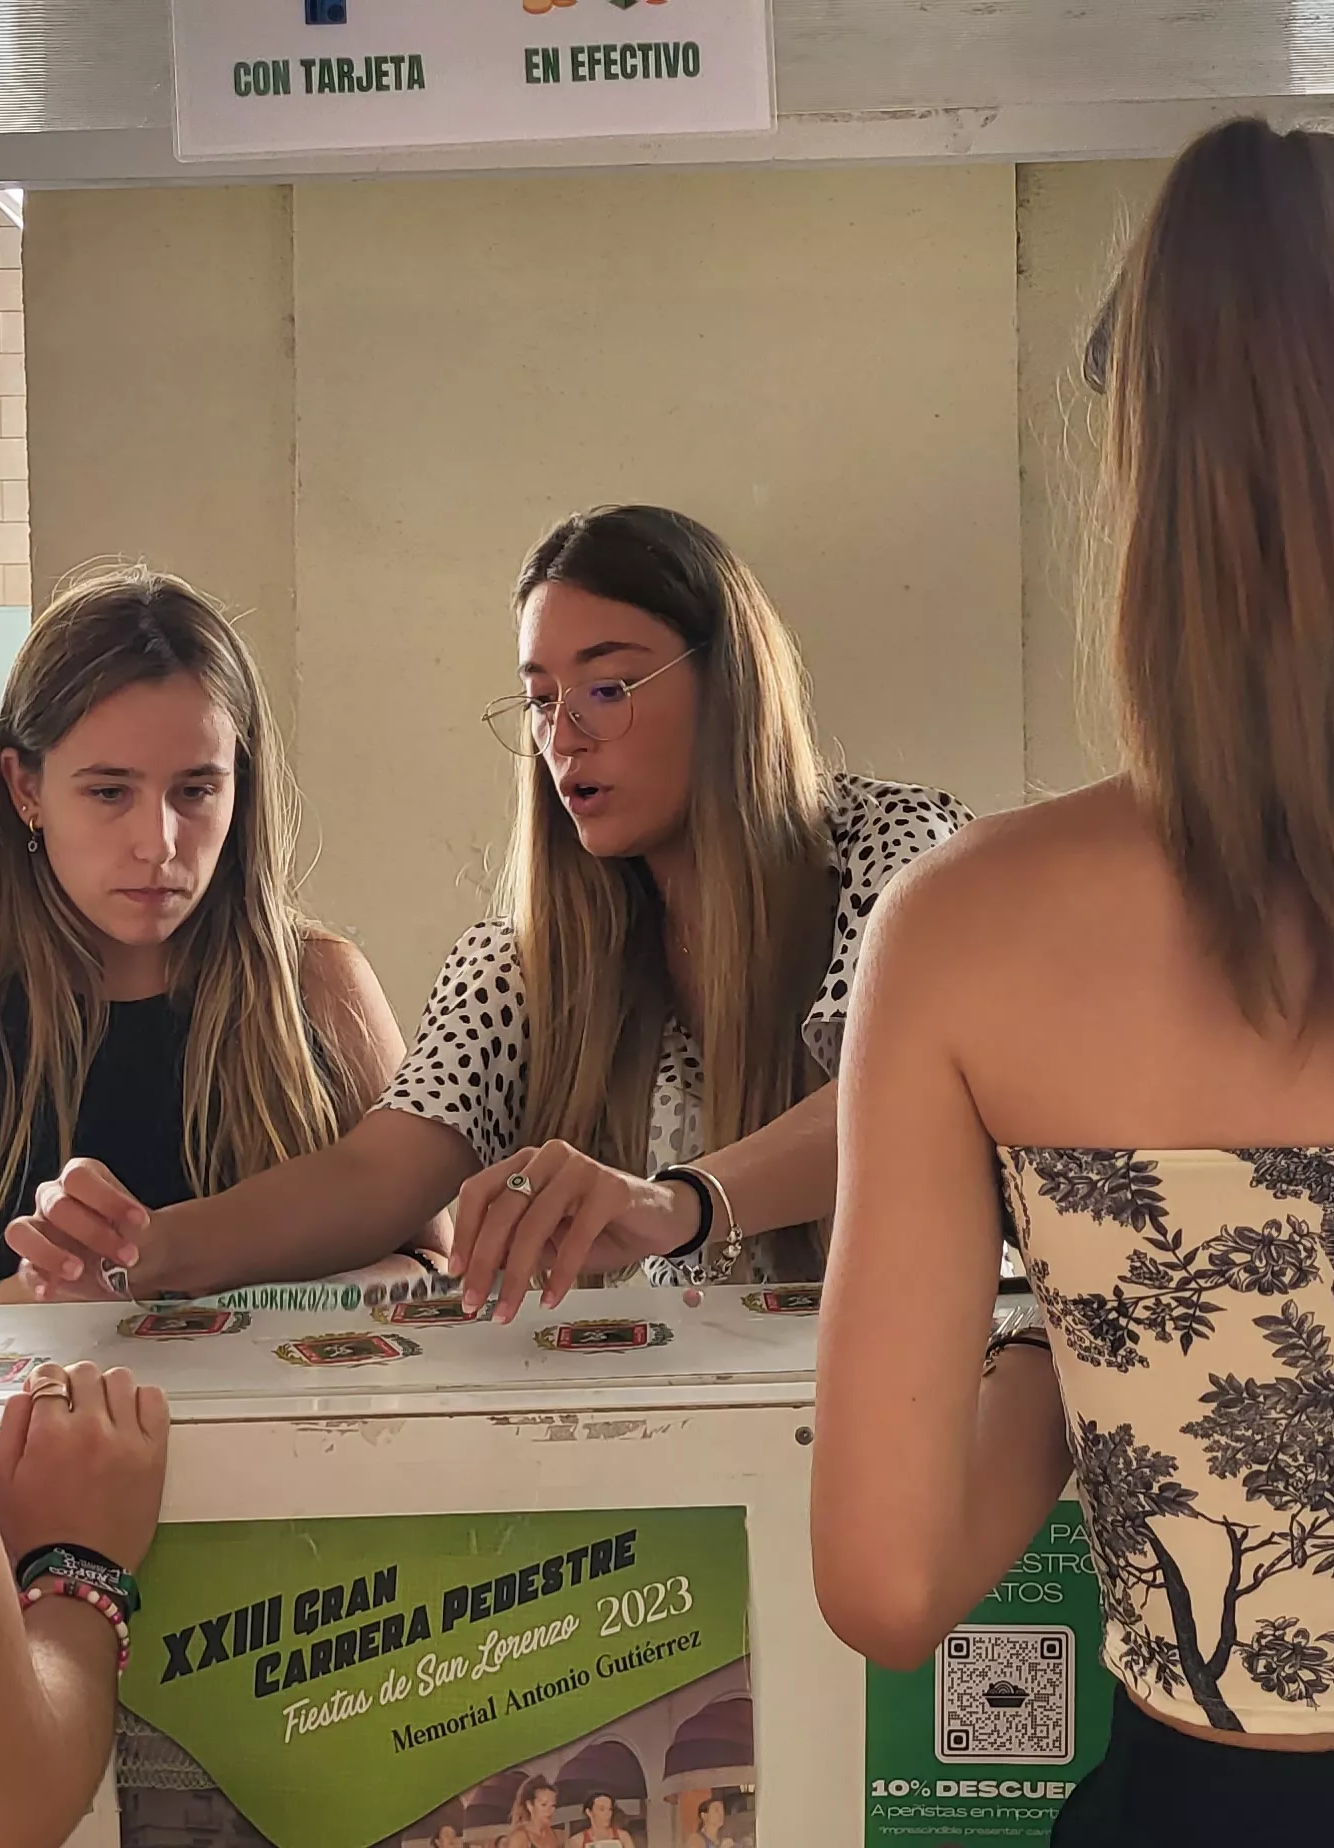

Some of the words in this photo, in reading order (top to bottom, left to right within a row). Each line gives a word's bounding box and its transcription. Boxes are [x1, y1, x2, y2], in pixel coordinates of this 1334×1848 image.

[233, 59, 291, 97] CON
[300, 54, 426, 95] TARJETA
[524, 47, 561, 84] EN
[570, 41, 701, 82] EFECTIVO
[217, 1289, 248, 1309] SAN
[160, 1594, 283, 1685] XXIII
[294, 1564, 399, 1637] GRAN
[255, 1604, 432, 1699] CARRERA
[442, 1528, 638, 1634] PEDESTRE
[282, 1685, 374, 1744] Fiestas
[379, 1668, 412, 1706] de
[416, 1651, 470, 1698] San
[471, 1611, 580, 1681] Lorenzo
[596, 1574, 695, 1638] 2023
[392, 1696, 499, 1754] Memorial
[504, 1666, 591, 1716] Antonio
[595, 1628, 703, 1682] Gutiérrez
[870, 1779, 931, 1797] 10%
[870, 1803, 885, 1817] A
[970, 1807, 994, 1818] en
